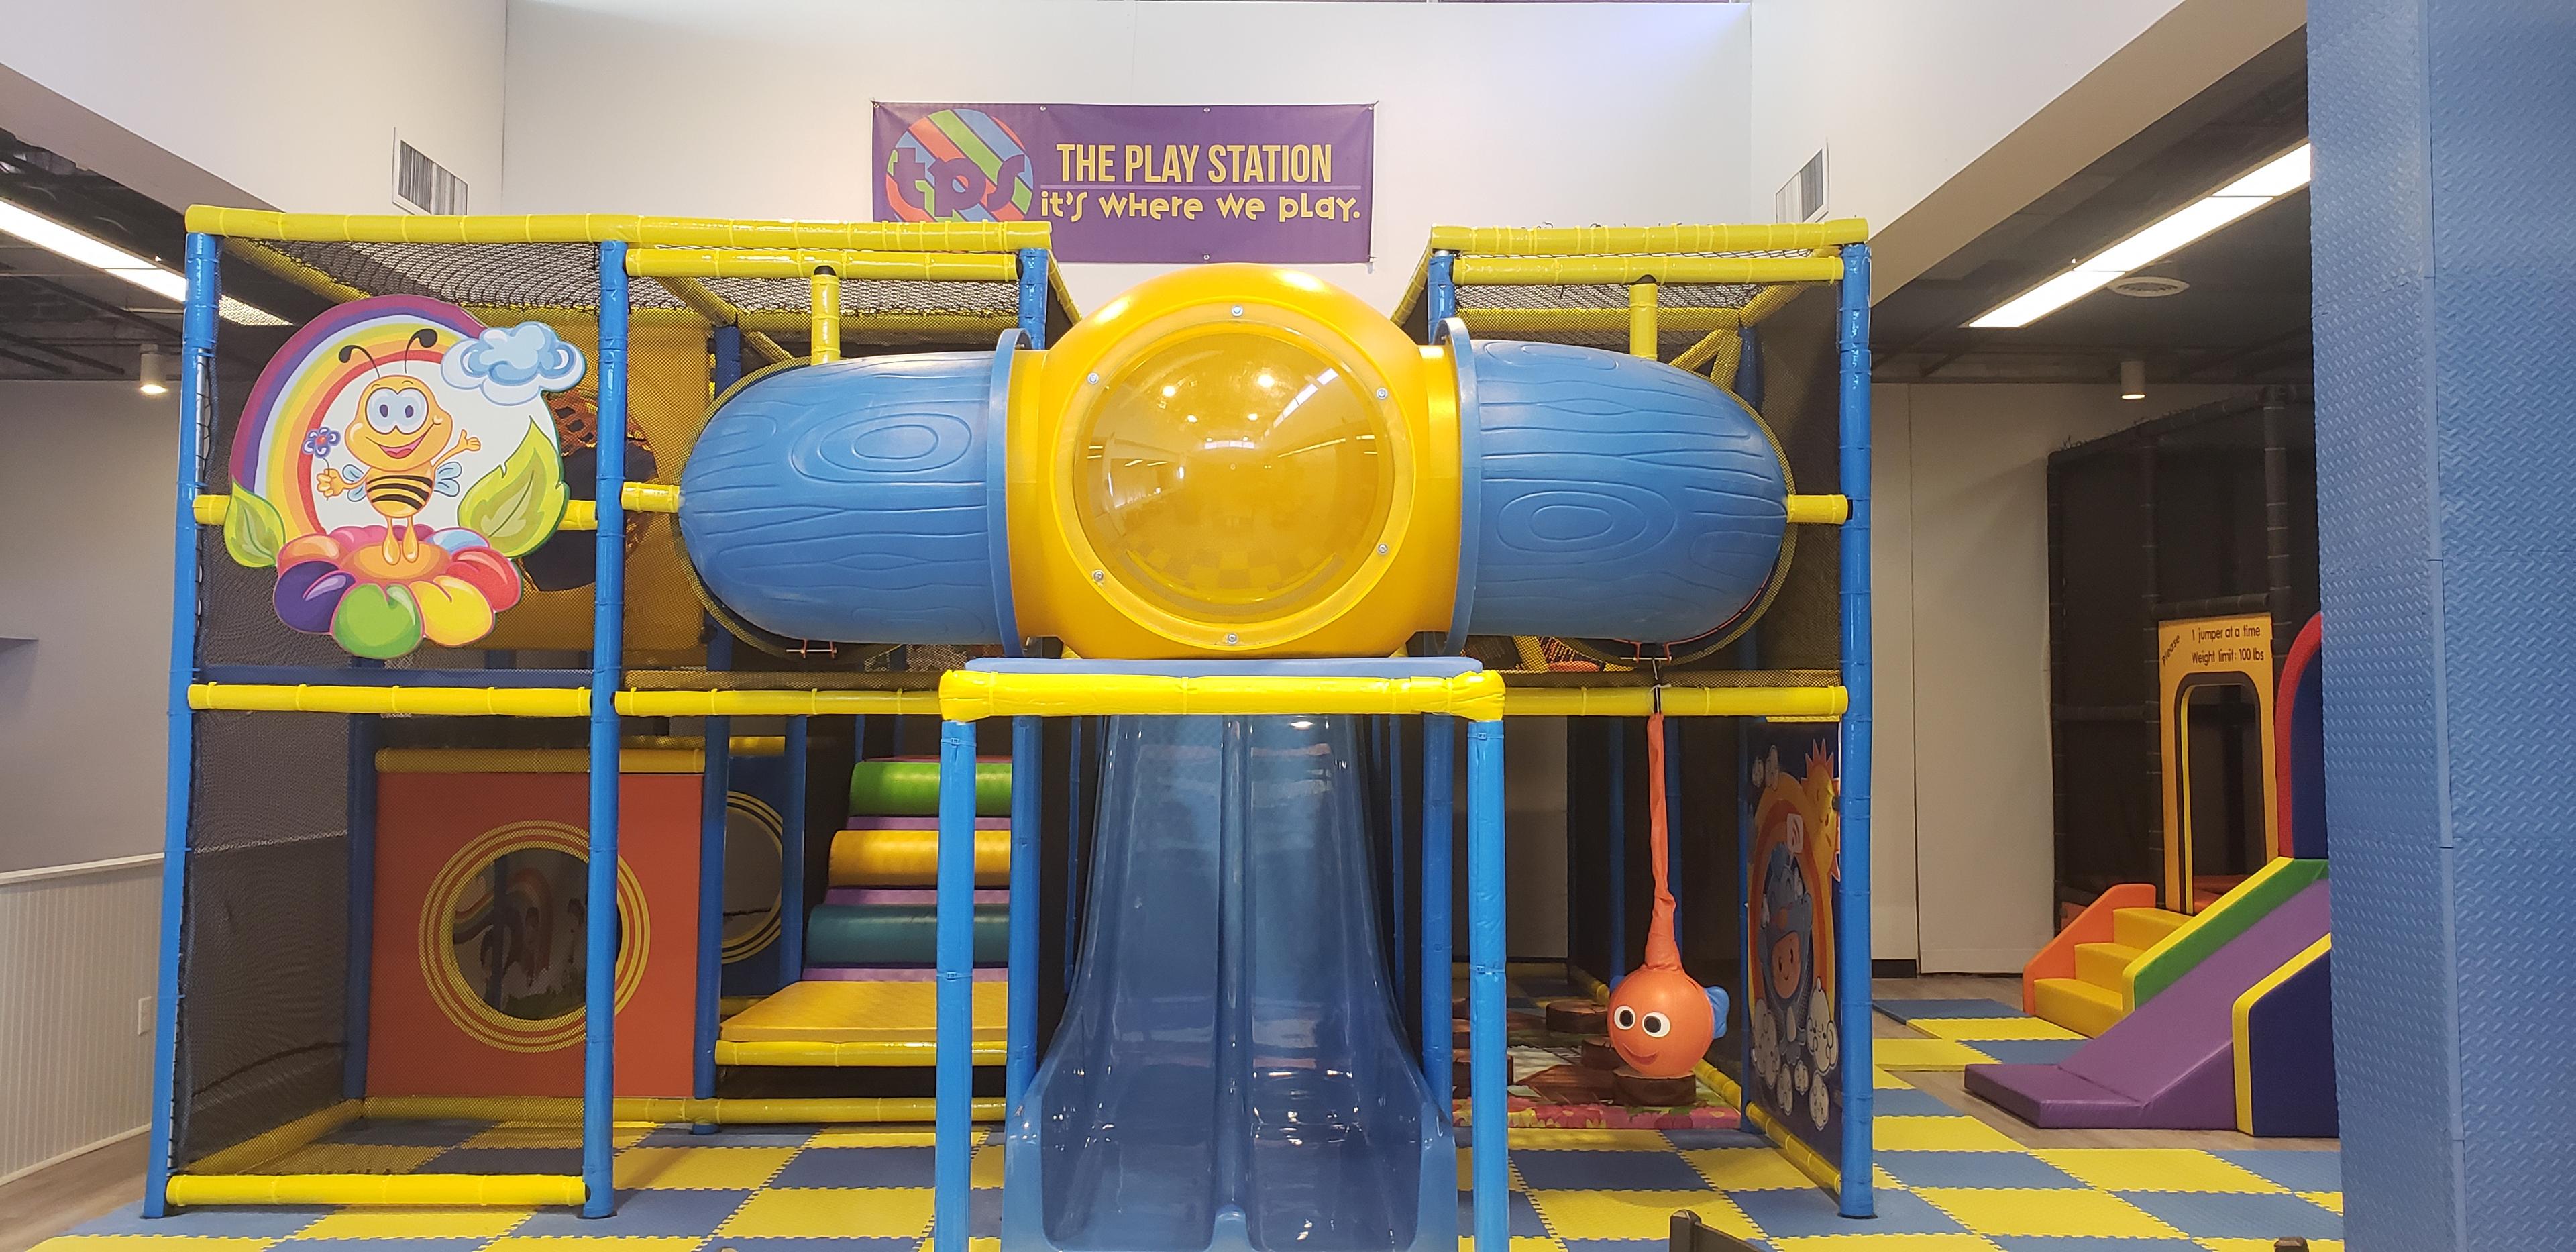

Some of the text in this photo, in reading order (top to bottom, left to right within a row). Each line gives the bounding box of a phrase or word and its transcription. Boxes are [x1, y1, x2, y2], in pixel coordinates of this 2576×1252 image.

[1056, 143, 1332, 184] THE PLAY STATION
[892, 146, 1026, 217] tps
[1040, 191, 1089, 222] it's
[2192, 624, 2261, 643] 1 jumper at a time
[2161, 635, 2180, 666] Please
[2192, 647, 2264, 666] Weight limit: 100 lbs
